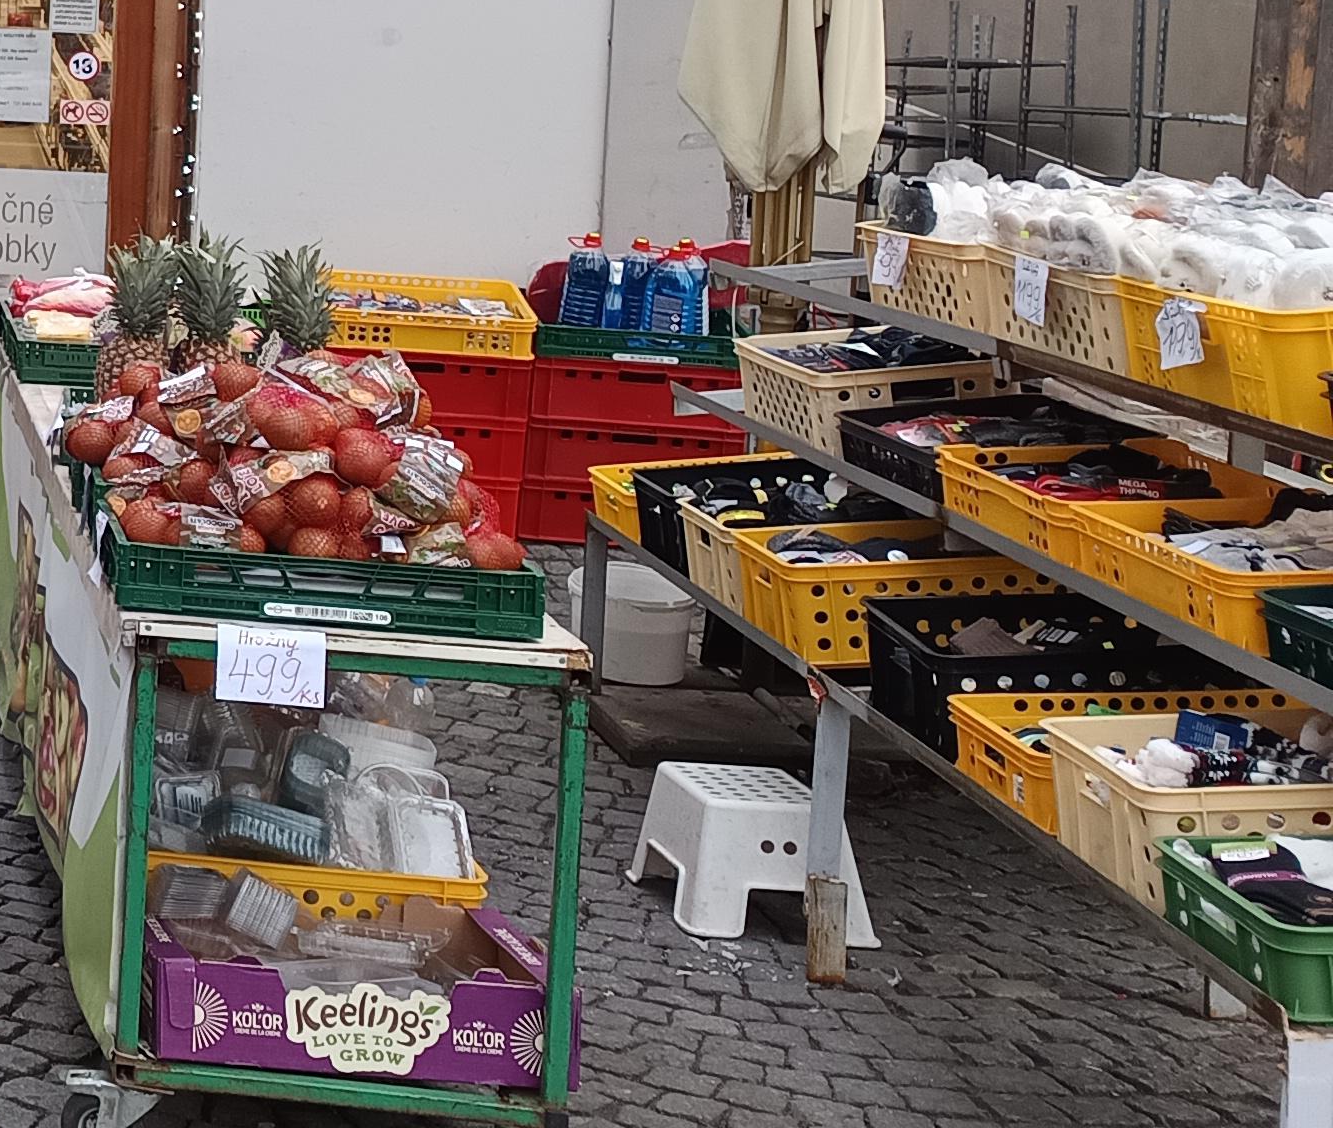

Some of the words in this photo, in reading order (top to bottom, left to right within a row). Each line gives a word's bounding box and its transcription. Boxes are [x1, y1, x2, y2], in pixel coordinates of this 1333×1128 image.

[1118, 478, 1147, 489] MEGA
[1119, 486, 1160, 499] THERMO
[189, 516, 235, 530] CHOCOLATE
[295, 991, 434, 1047] Keelings
[311, 1032, 366, 1048] LOVE
[372, 1034, 393, 1048] TO
[339, 1048, 405, 1066] GROW
